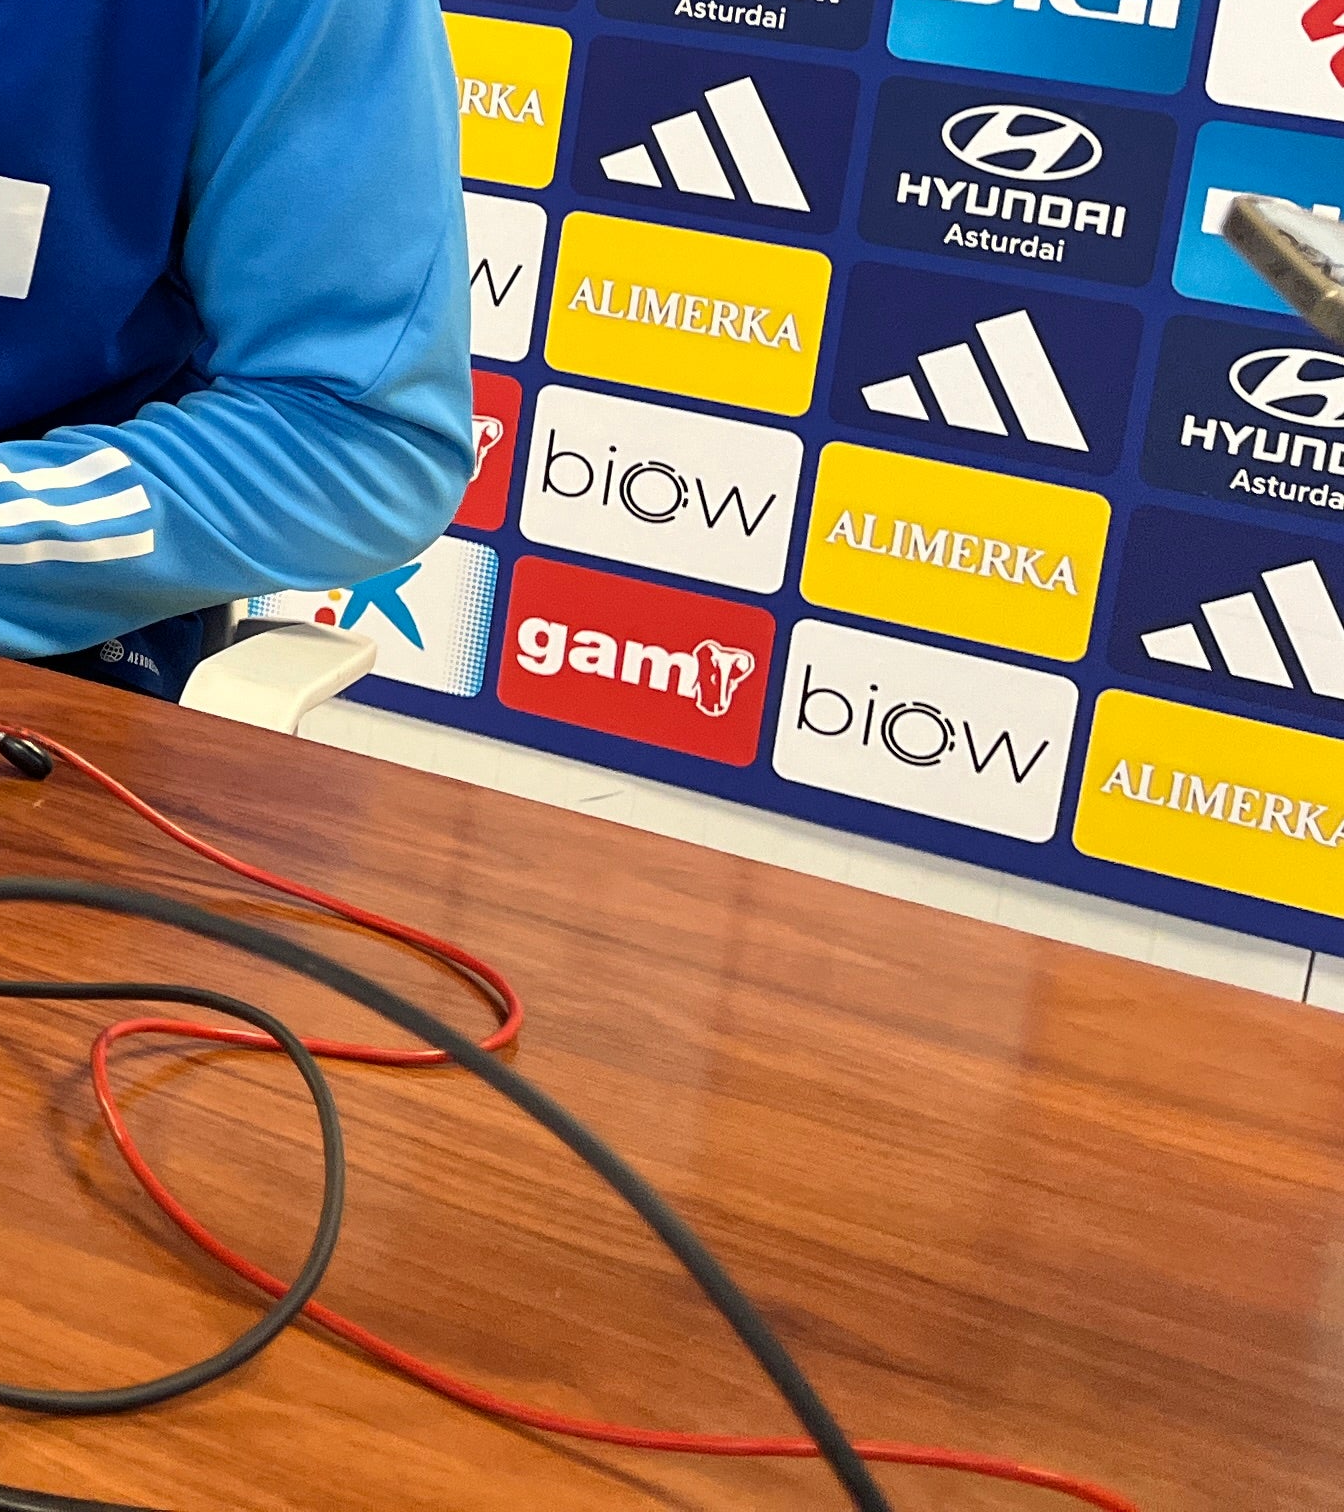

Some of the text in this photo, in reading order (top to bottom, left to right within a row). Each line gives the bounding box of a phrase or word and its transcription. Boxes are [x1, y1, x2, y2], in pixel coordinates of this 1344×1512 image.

[896, 172, 1127, 238] HYUNDAI
[944, 222, 1065, 263] Asturdai
[568, 276, 802, 352] ALIMERKA
[1180, 414, 1344, 476] HYUN
[543, 429, 776, 536] biow
[1229, 468, 1344, 510] Asturda
[826, 509, 1078, 596] ALIMERKA
[797, 664, 1049, 784] biow
